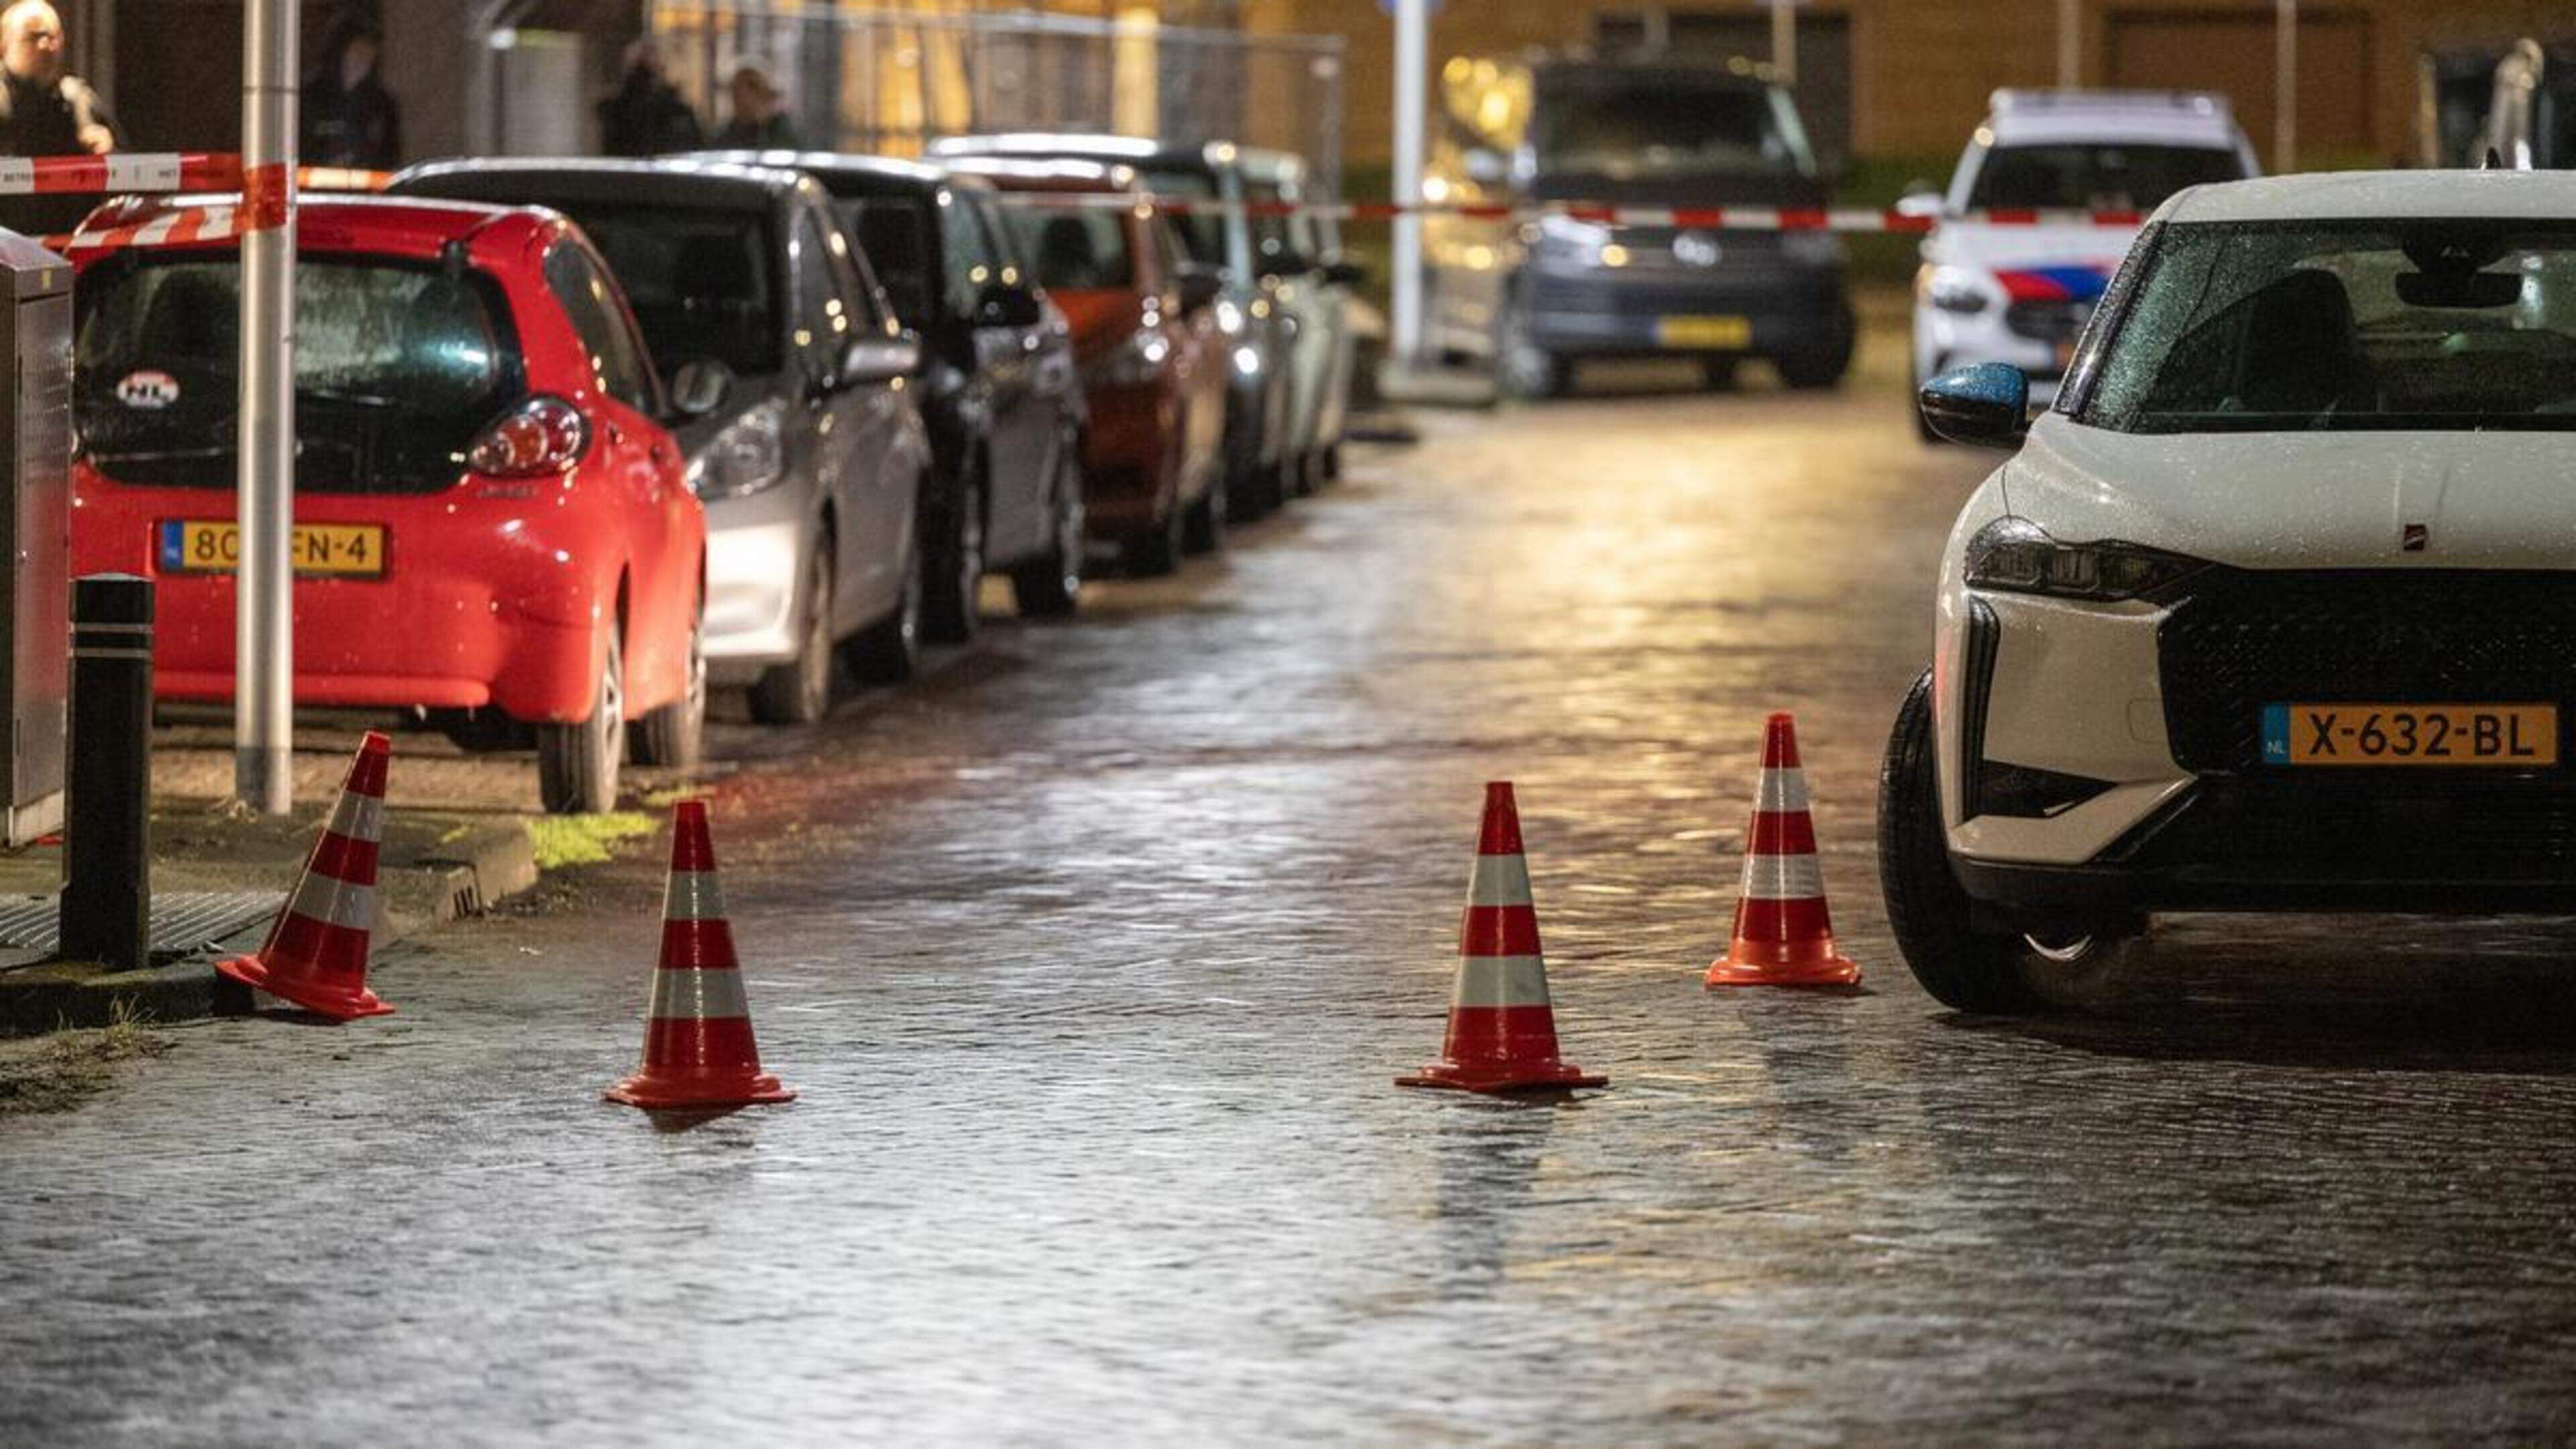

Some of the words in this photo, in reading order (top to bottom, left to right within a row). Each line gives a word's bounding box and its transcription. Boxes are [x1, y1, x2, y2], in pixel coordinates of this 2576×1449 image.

[195, 529, 366, 564] 80N-4
[2267, 740, 2285, 754] NL
[2310, 714, 2534, 756] X-632-BL
